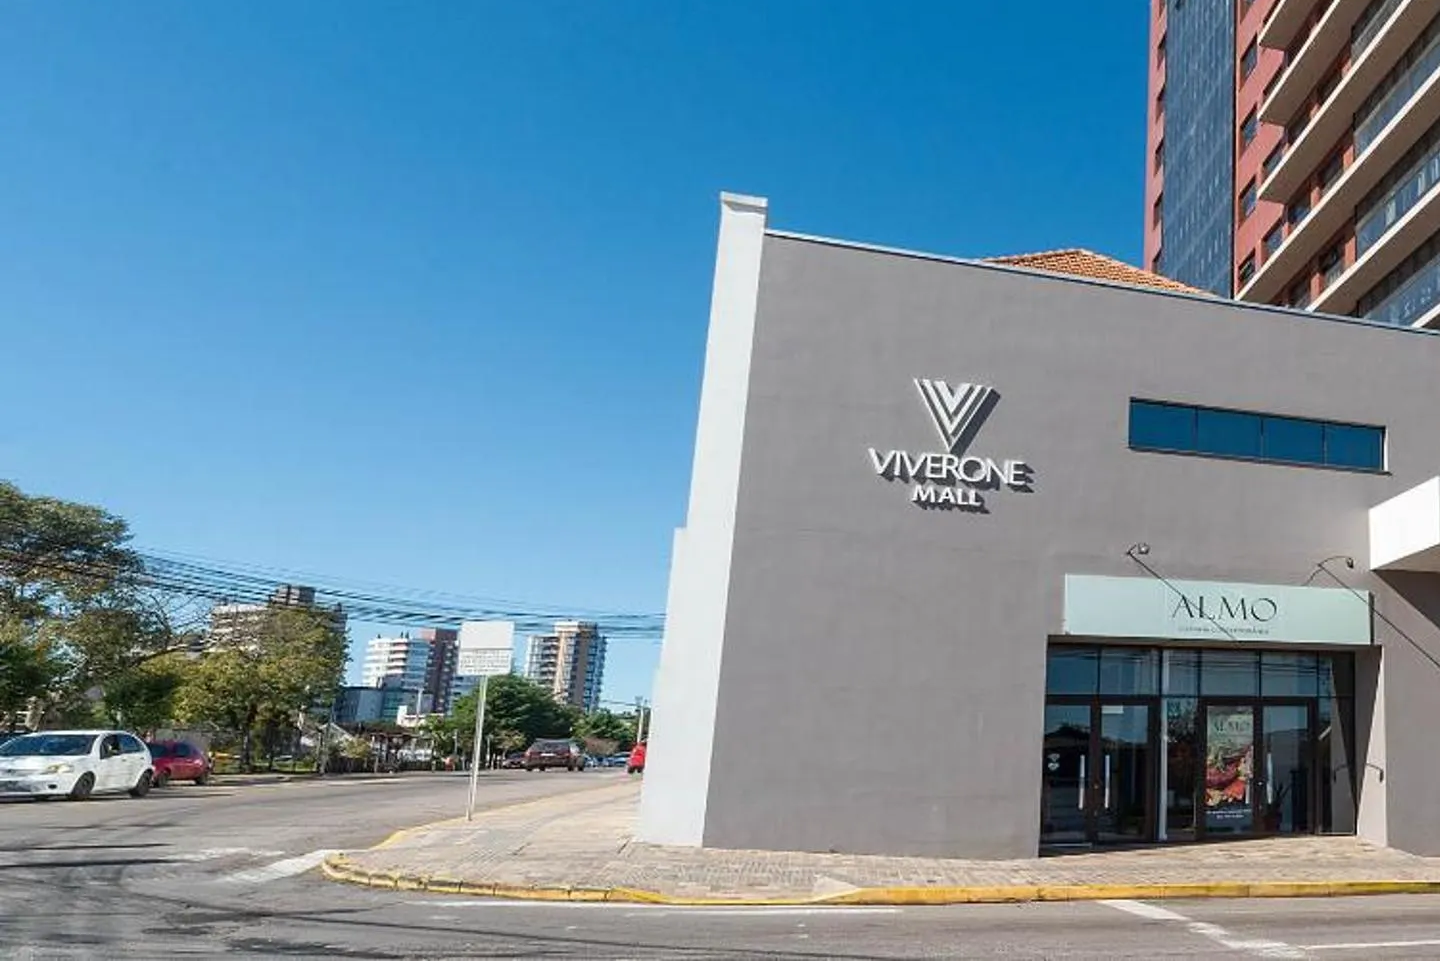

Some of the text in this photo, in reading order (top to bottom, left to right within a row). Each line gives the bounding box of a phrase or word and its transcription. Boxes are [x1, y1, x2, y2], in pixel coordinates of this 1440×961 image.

[867, 447, 1028, 485] VIVERONE
[911, 484, 982, 506] MALL
[1172, 594, 1277, 622] ALMO
